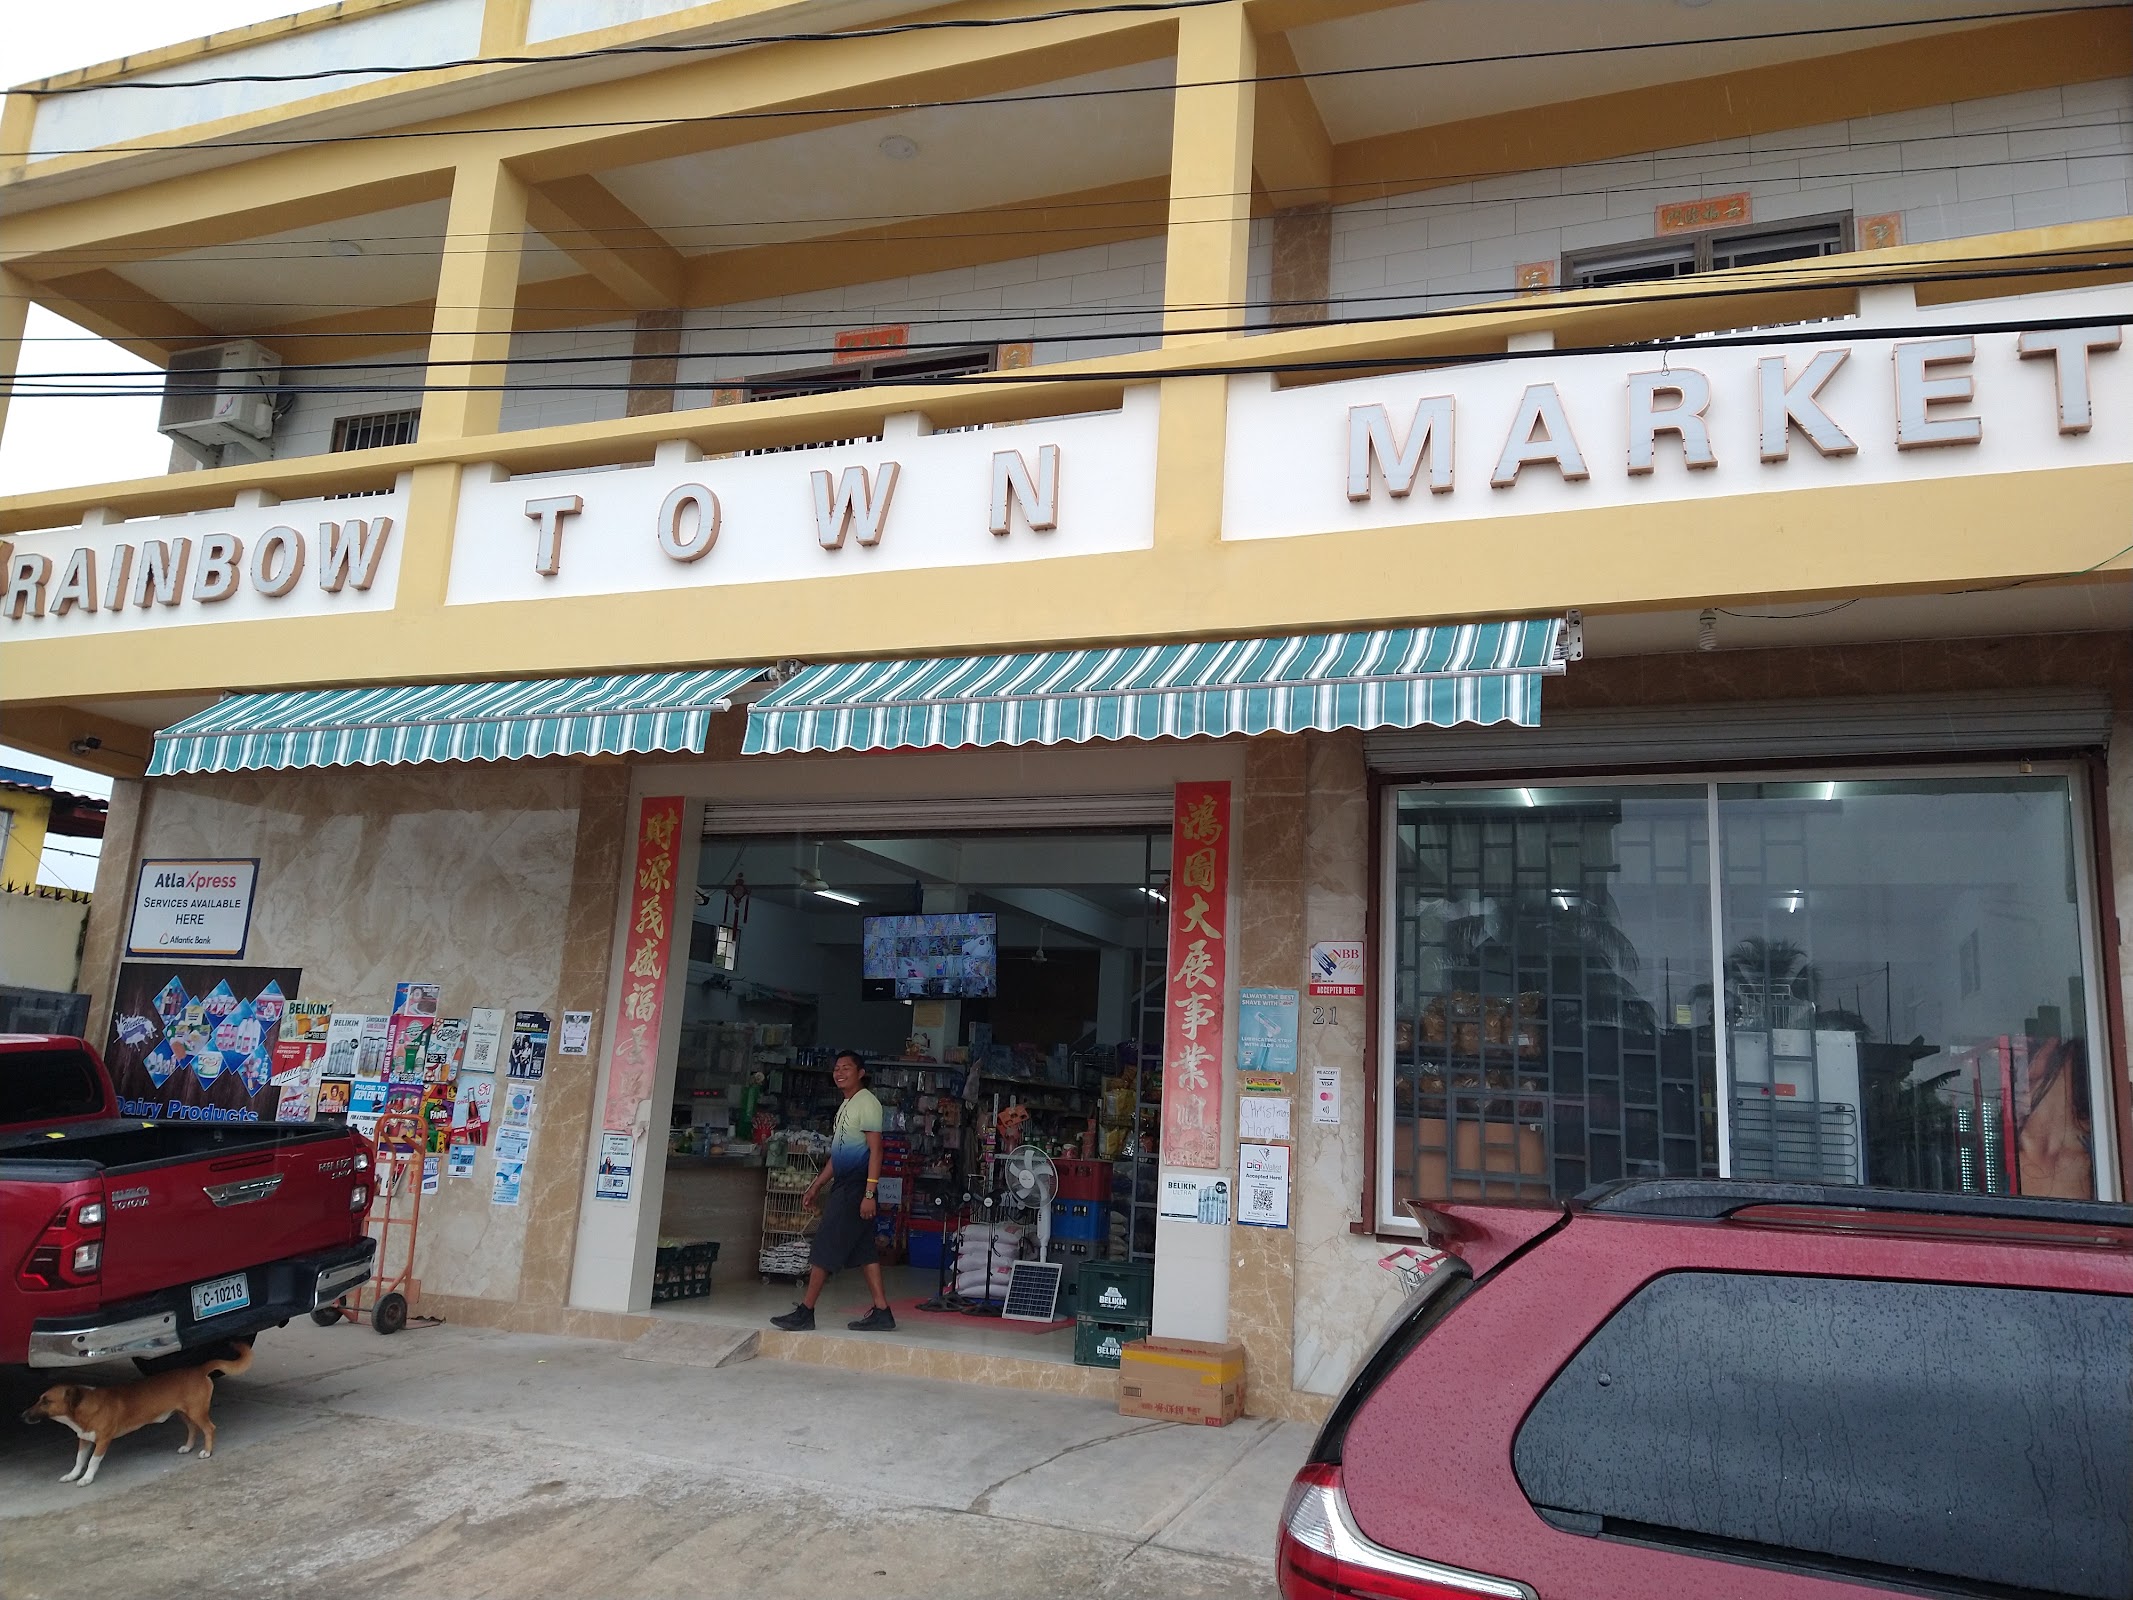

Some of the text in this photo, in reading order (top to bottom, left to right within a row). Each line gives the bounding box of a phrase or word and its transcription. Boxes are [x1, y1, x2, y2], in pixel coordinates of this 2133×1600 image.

[3, 325, 2123, 620] RAINBOW TOWN MARKET
[154, 870, 237, 893] AtlaXpress
[190, 898, 242, 909] AVAILABLE
[174, 913, 205, 925] HERE
[169, 935, 211, 945] Atlantic Bank
[1332, 948, 1360, 959] NBB
[1241, 992, 1267, 1000] ALWAYS
[1316, 985, 1357, 995] ACCEPTED HERE
[289, 1002, 328, 1015] BELIKIN
[1312, 1005, 1339, 1026] 21
[478, 1082, 491, 1096] $1
[116, 1096, 259, 1122] Dairy Products
[1244, 1120, 1275, 1137] Ham
[1245, 1173, 1269, 1181] Accepted
[1167, 1181, 1197, 1190] BELIKIN
[203, 1282, 243, 1307] C-10218
[1099, 1295, 1127, 1306] BELIKIN
